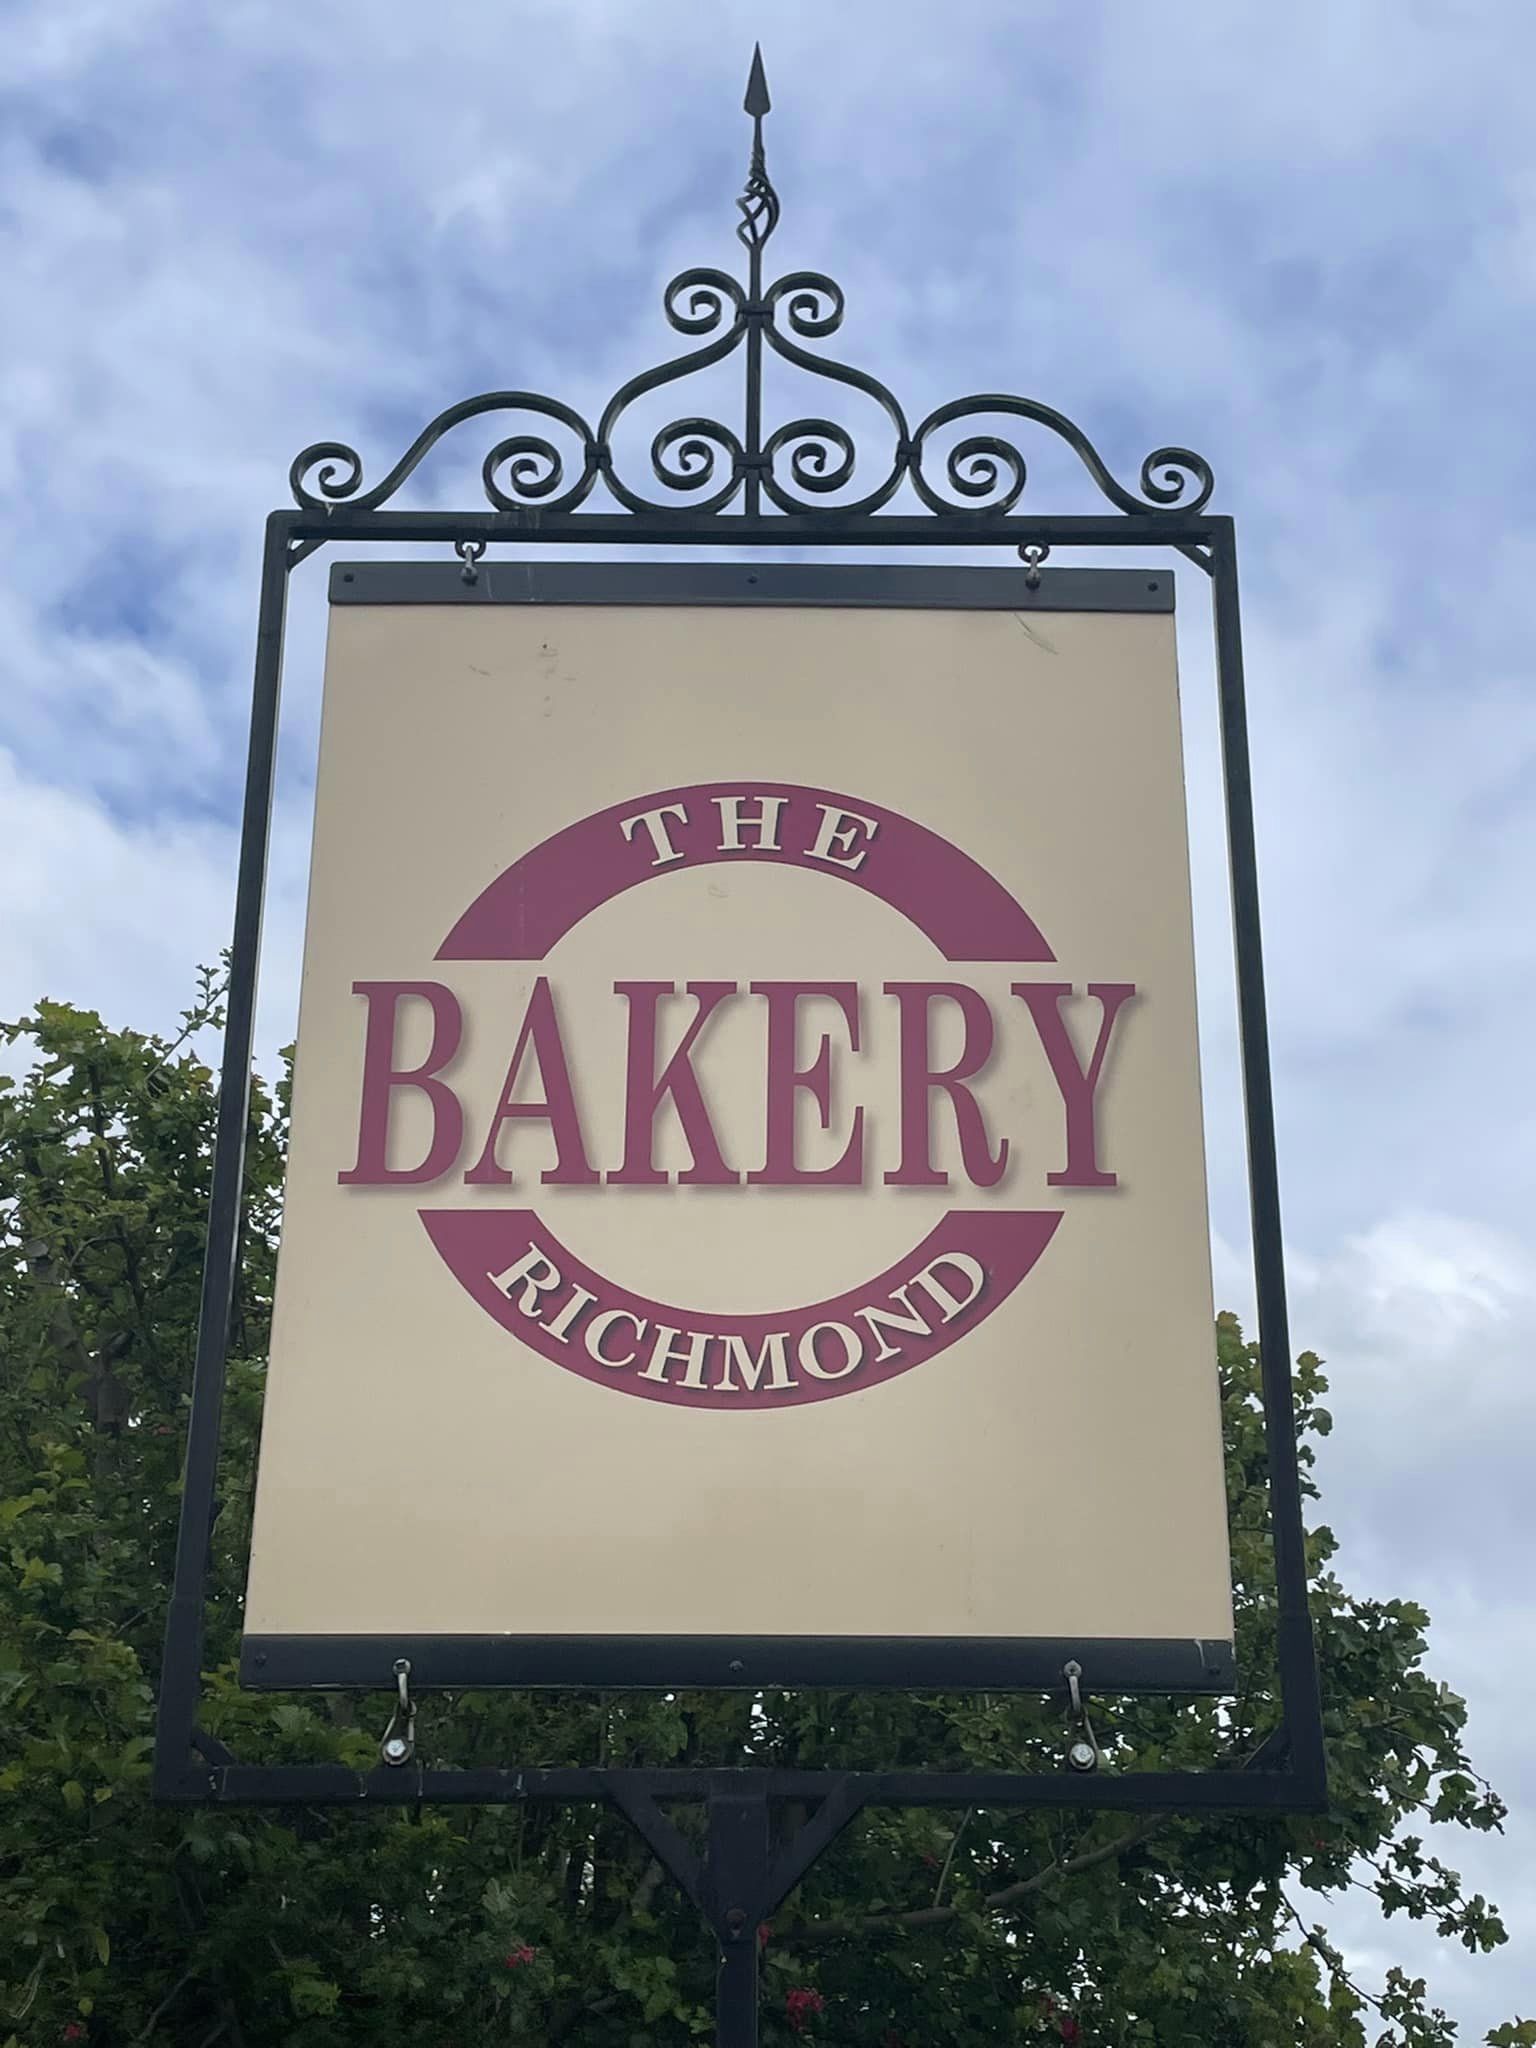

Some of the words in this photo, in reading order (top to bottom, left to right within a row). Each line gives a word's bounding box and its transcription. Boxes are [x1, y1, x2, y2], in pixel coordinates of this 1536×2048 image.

[619, 796, 880, 871] THE
[338, 977, 1137, 1187] BAKERY
[486, 1241, 987, 1391] RICHMOND
